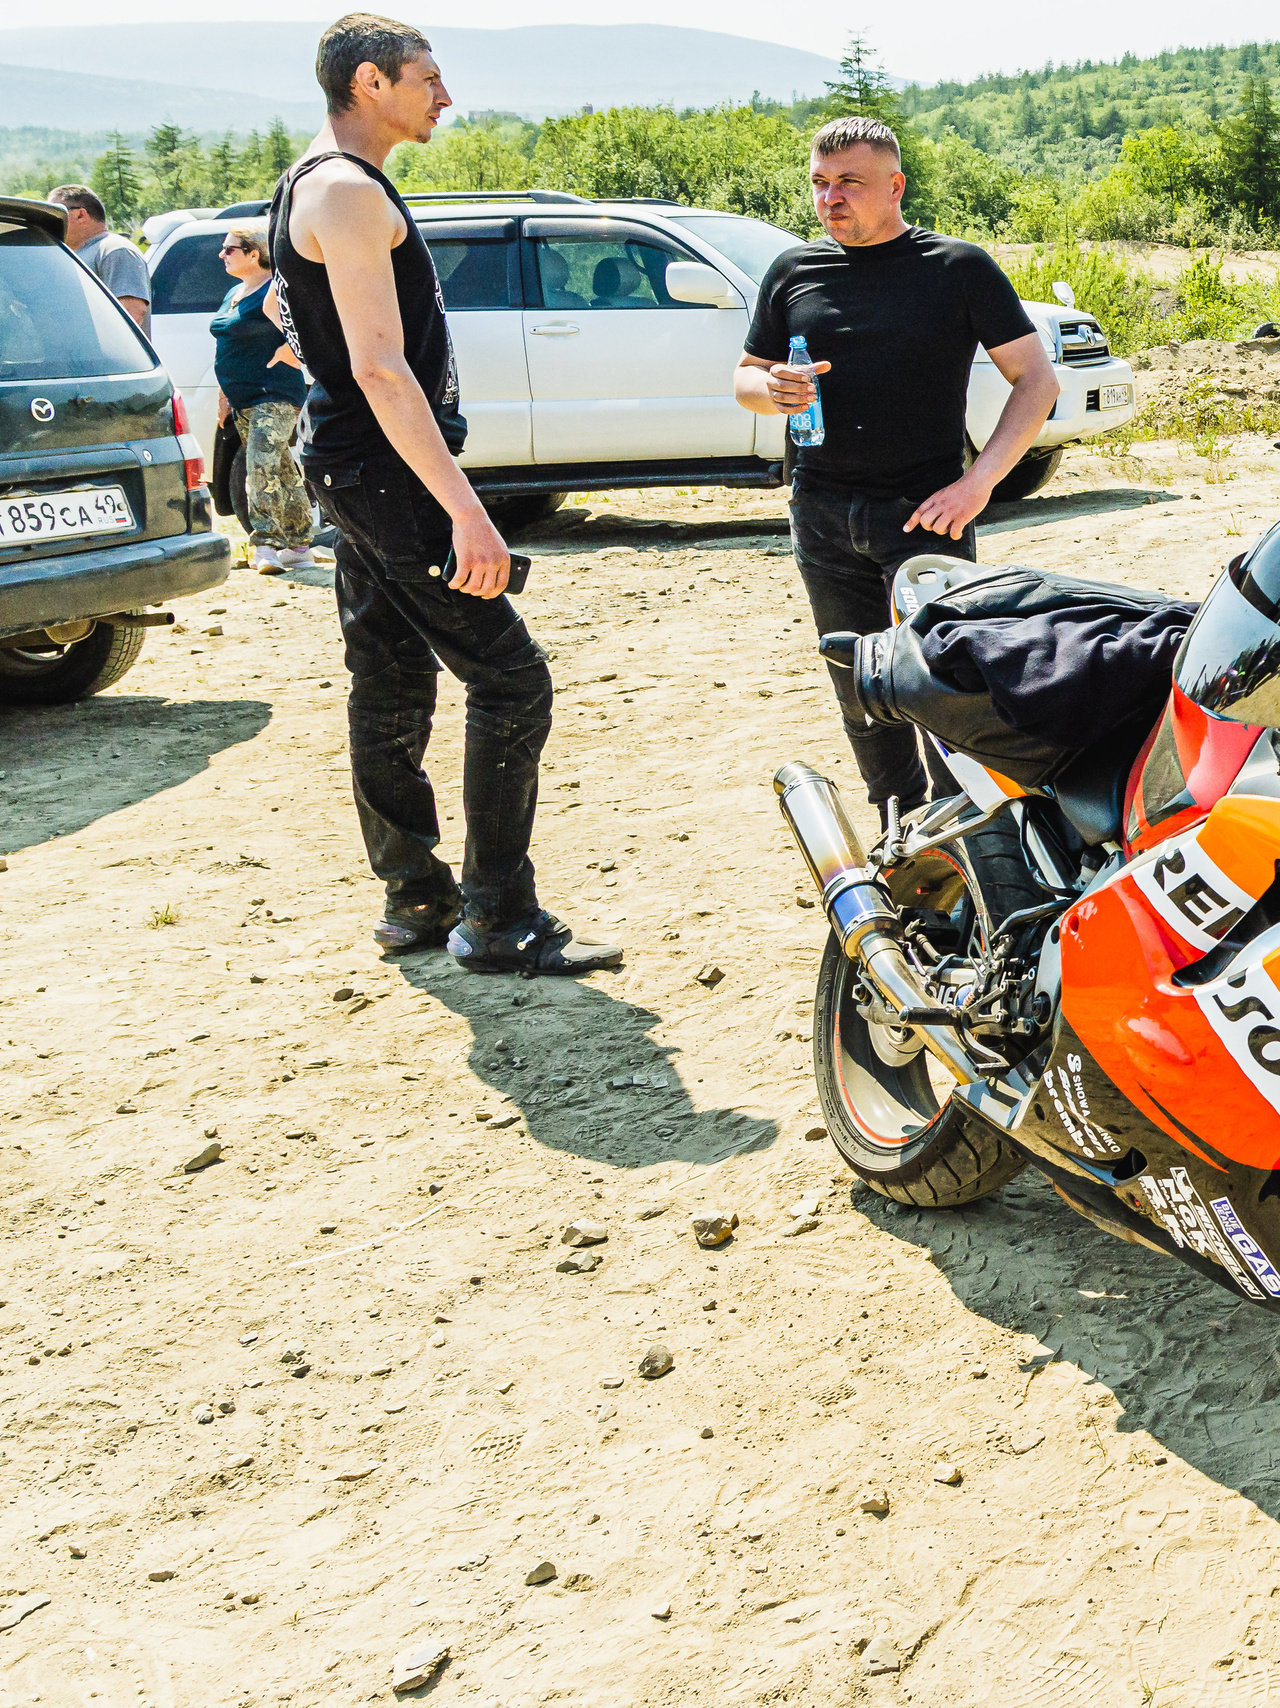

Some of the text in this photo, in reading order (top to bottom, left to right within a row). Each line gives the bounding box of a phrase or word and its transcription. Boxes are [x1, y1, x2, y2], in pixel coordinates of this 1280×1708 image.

[95, 494, 116, 515] 49
[97, 516, 115, 525] RUS
[1043, 1069, 1095, 1158] brembo
[1141, 1176, 1193, 1248] RK
[1157, 1179, 1202, 1253] SPARK PLUGS
[1161, 1178, 1214, 1253] NGK
[1214, 1204, 1235, 1233] JEANS
[1221, 1203, 1241, 1233] BLUE
[1194, 1205, 1260, 1297] MICHELIN
